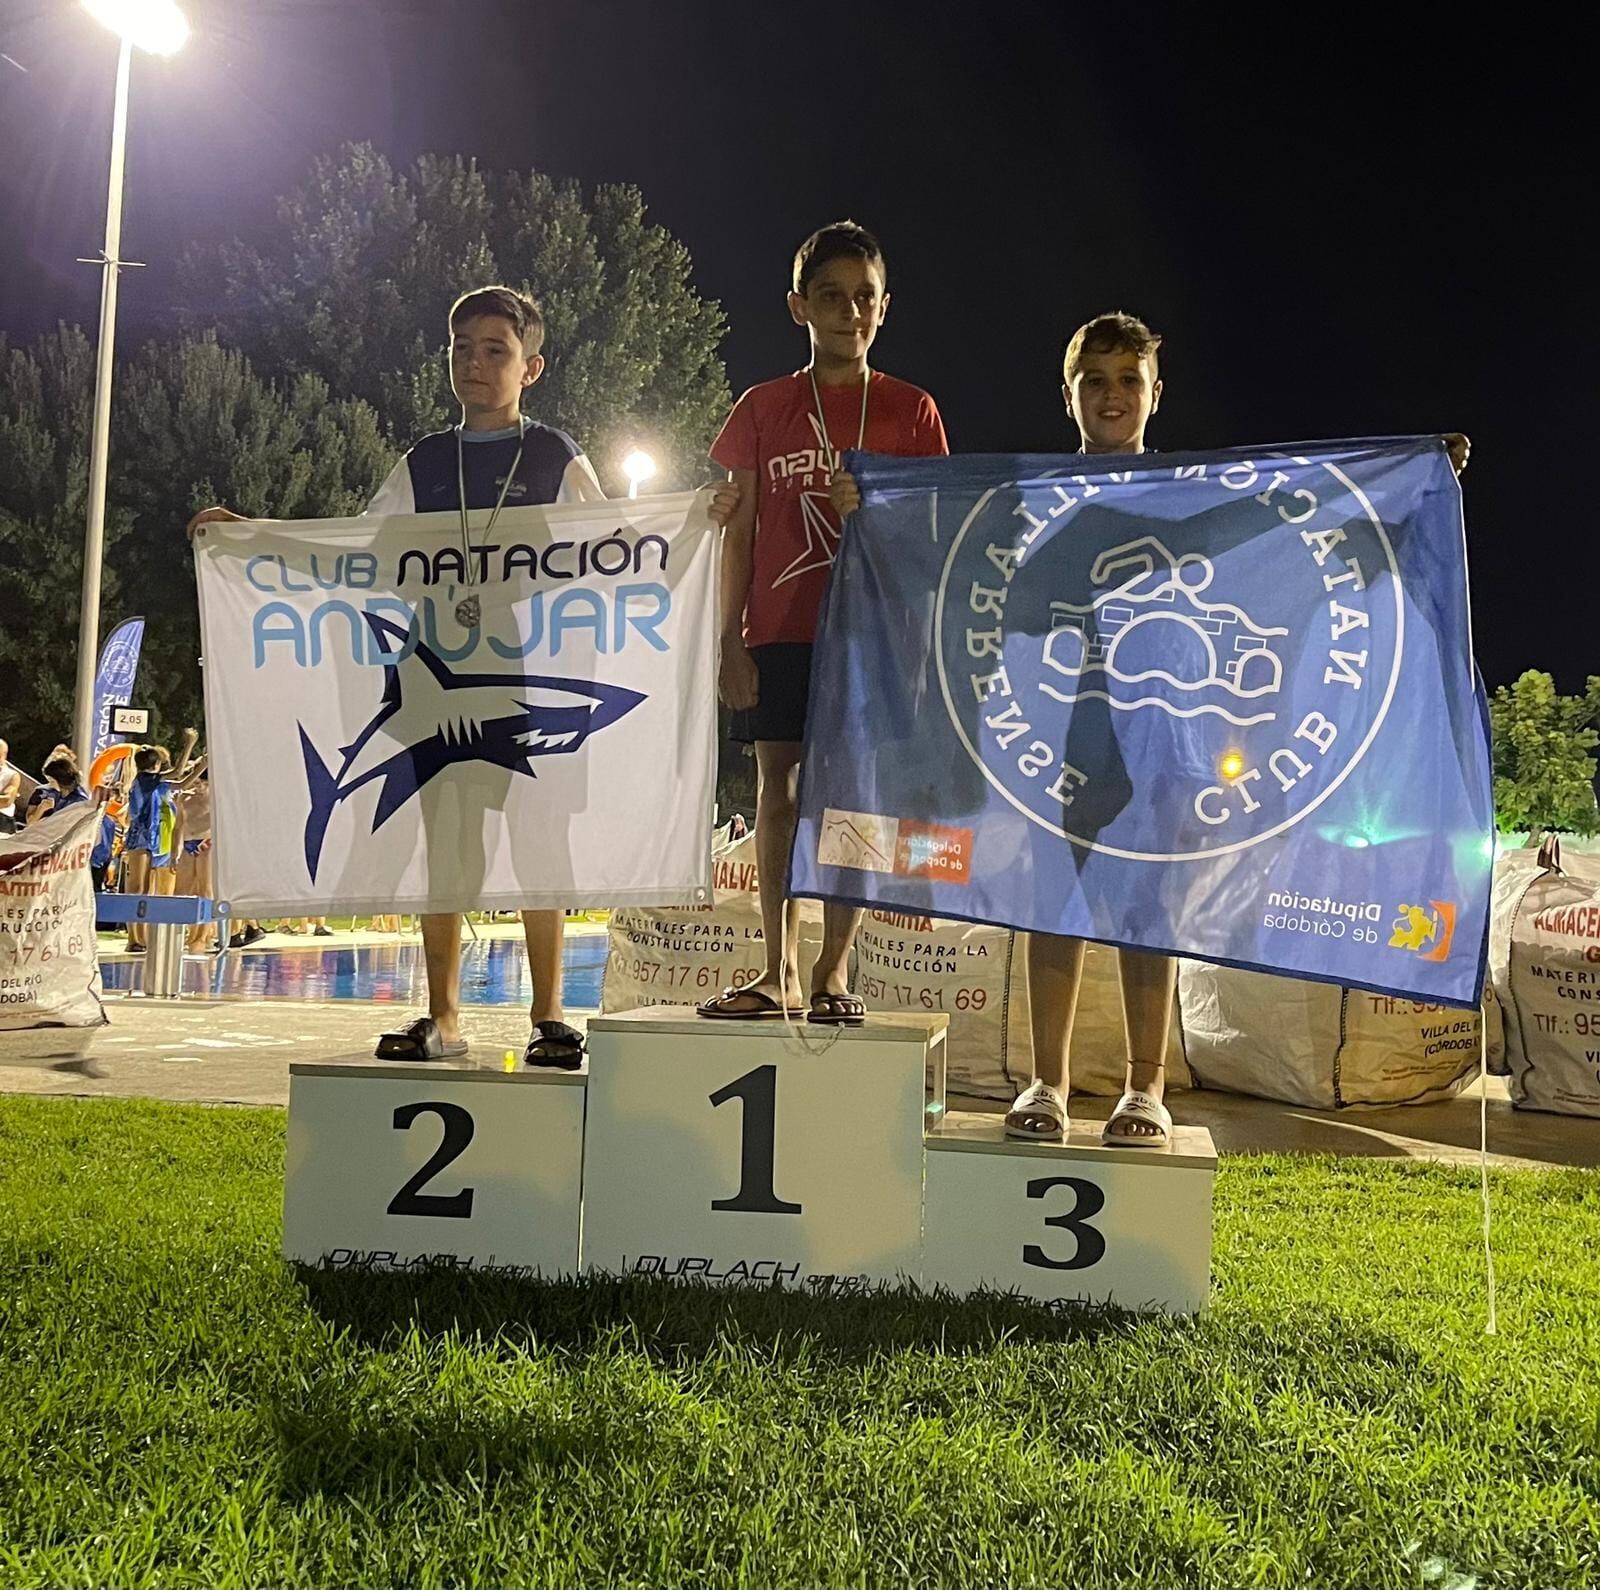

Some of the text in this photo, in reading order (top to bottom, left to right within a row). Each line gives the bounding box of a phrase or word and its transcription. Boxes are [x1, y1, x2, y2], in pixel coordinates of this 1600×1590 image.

[245, 552, 377, 592] CLUB
[693, 925, 734, 937] PARA
[745, 927, 764, 939] LA
[1534, 907, 1600, 939] ALMACE
[626, 931, 734, 953] CONSTRUCCIÓN
[862, 930, 988, 957] RIALES PARA LA
[1, 977, 22, 989] DEL
[668, 965, 690, 987] 17
[696, 966, 721, 987] 61
[1531, 965, 1596, 984] MATERI
[0, 990, 38, 1004] DOBA)
[894, 984, 912, 1006] 17
[920, 988, 943, 1009] 61
[955, 988, 987, 1011] 69
[1421, 1024, 1449, 1039] VILLA
[1452, 1021, 1472, 1033] DEL
[708, 1064, 802, 1215] 1
[387, 1101, 475, 1218] 2
[1023, 1176, 1106, 1270] 3
[635, 1255, 800, 1282] DUPLACH
